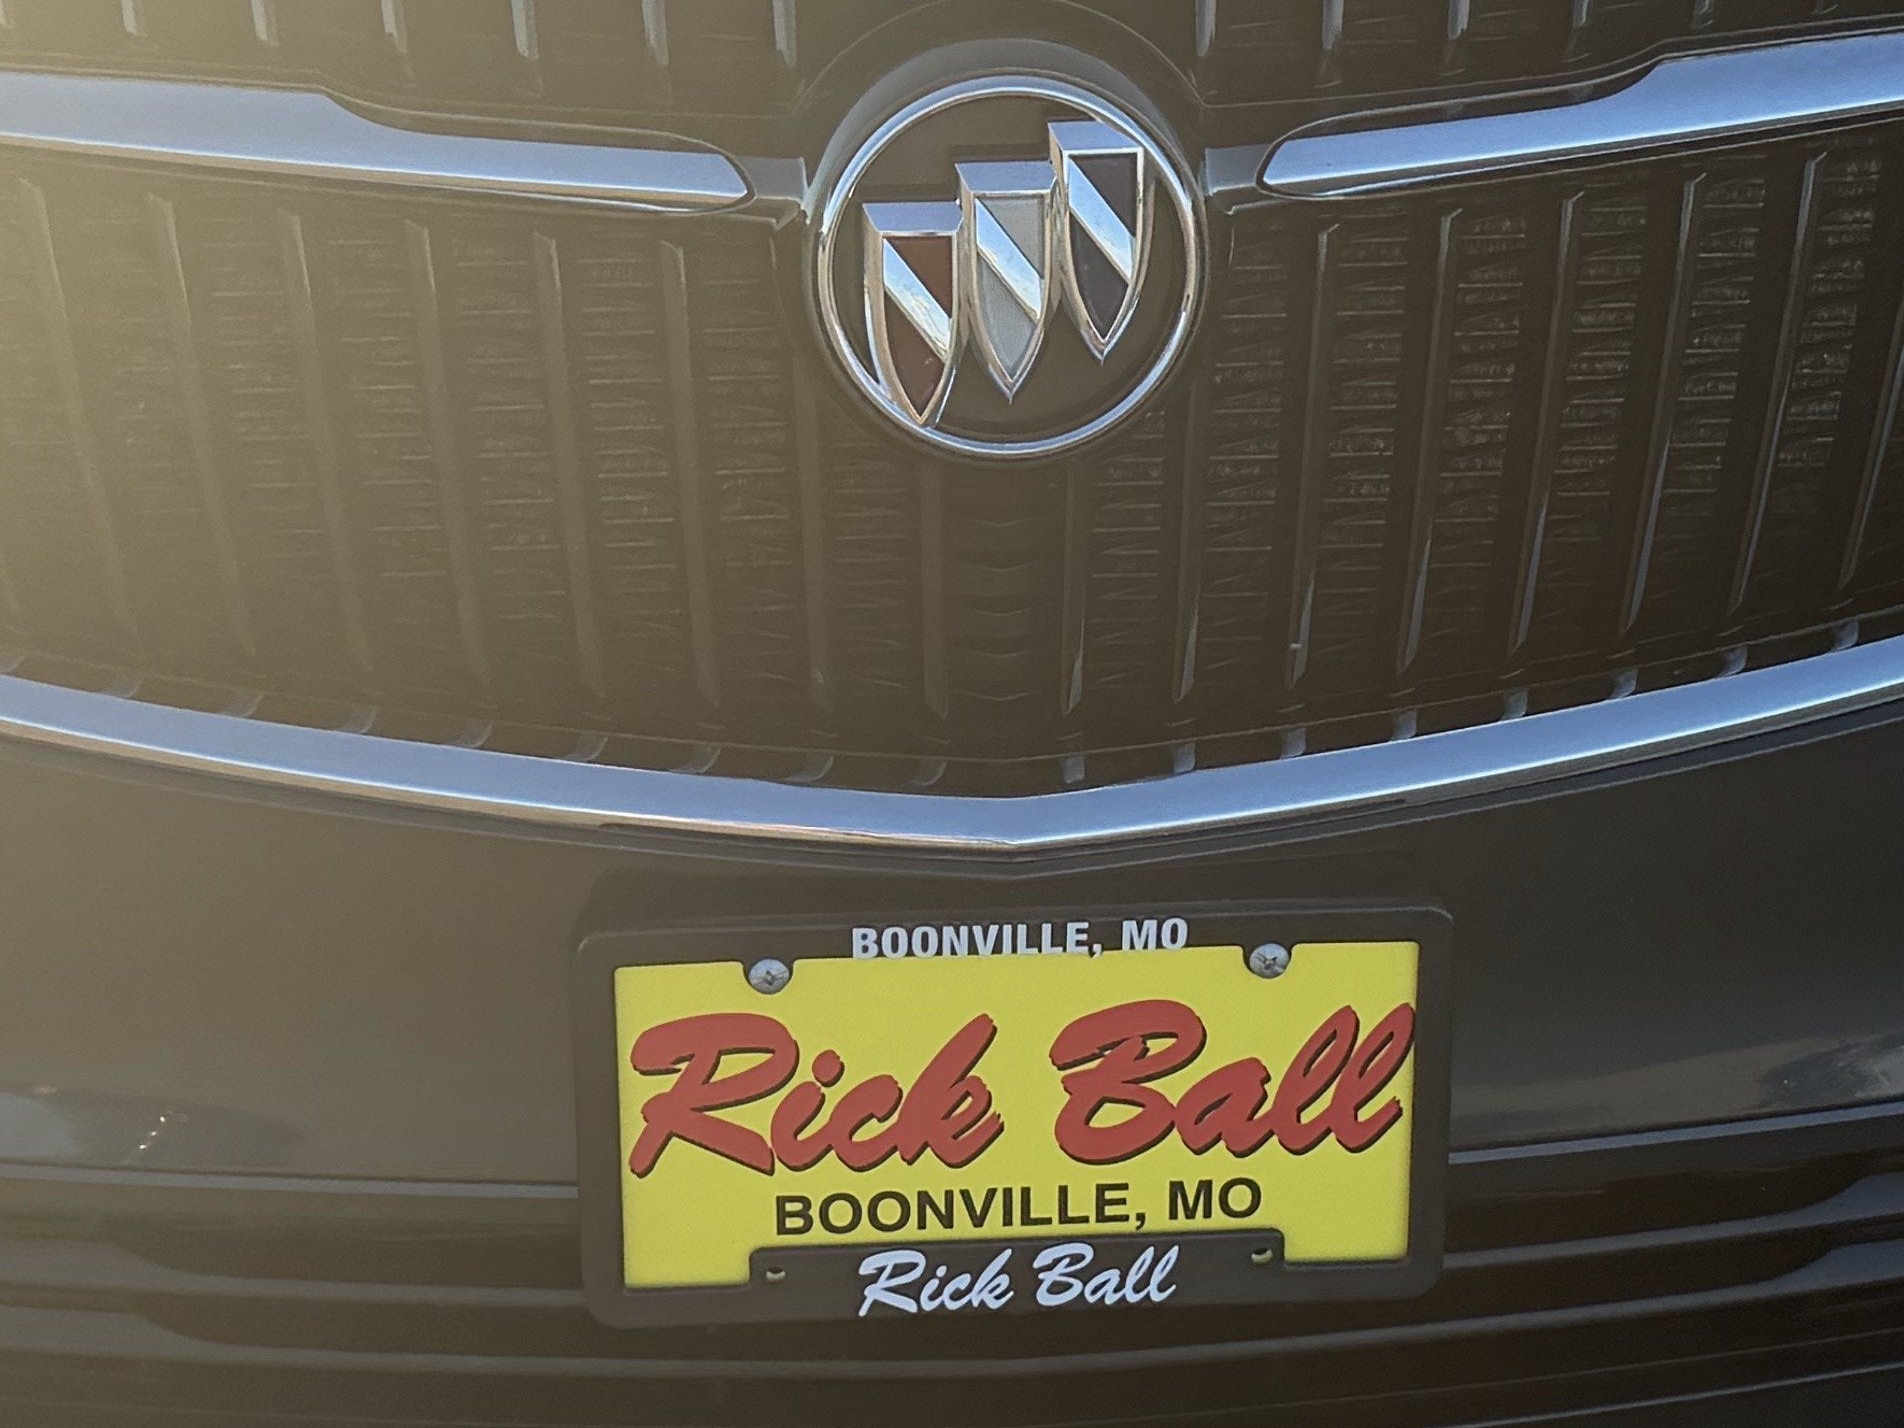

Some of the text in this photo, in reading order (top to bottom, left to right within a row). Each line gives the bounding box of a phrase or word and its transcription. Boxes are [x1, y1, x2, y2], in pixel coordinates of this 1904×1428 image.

[851, 917, 1189, 960] BOONVILLE, MO
[629, 998, 1416, 1178] Rick Ball
[774, 1177, 1263, 1236] BOONVILLE, MO
[858, 1241, 1179, 1318] Rick Ball
